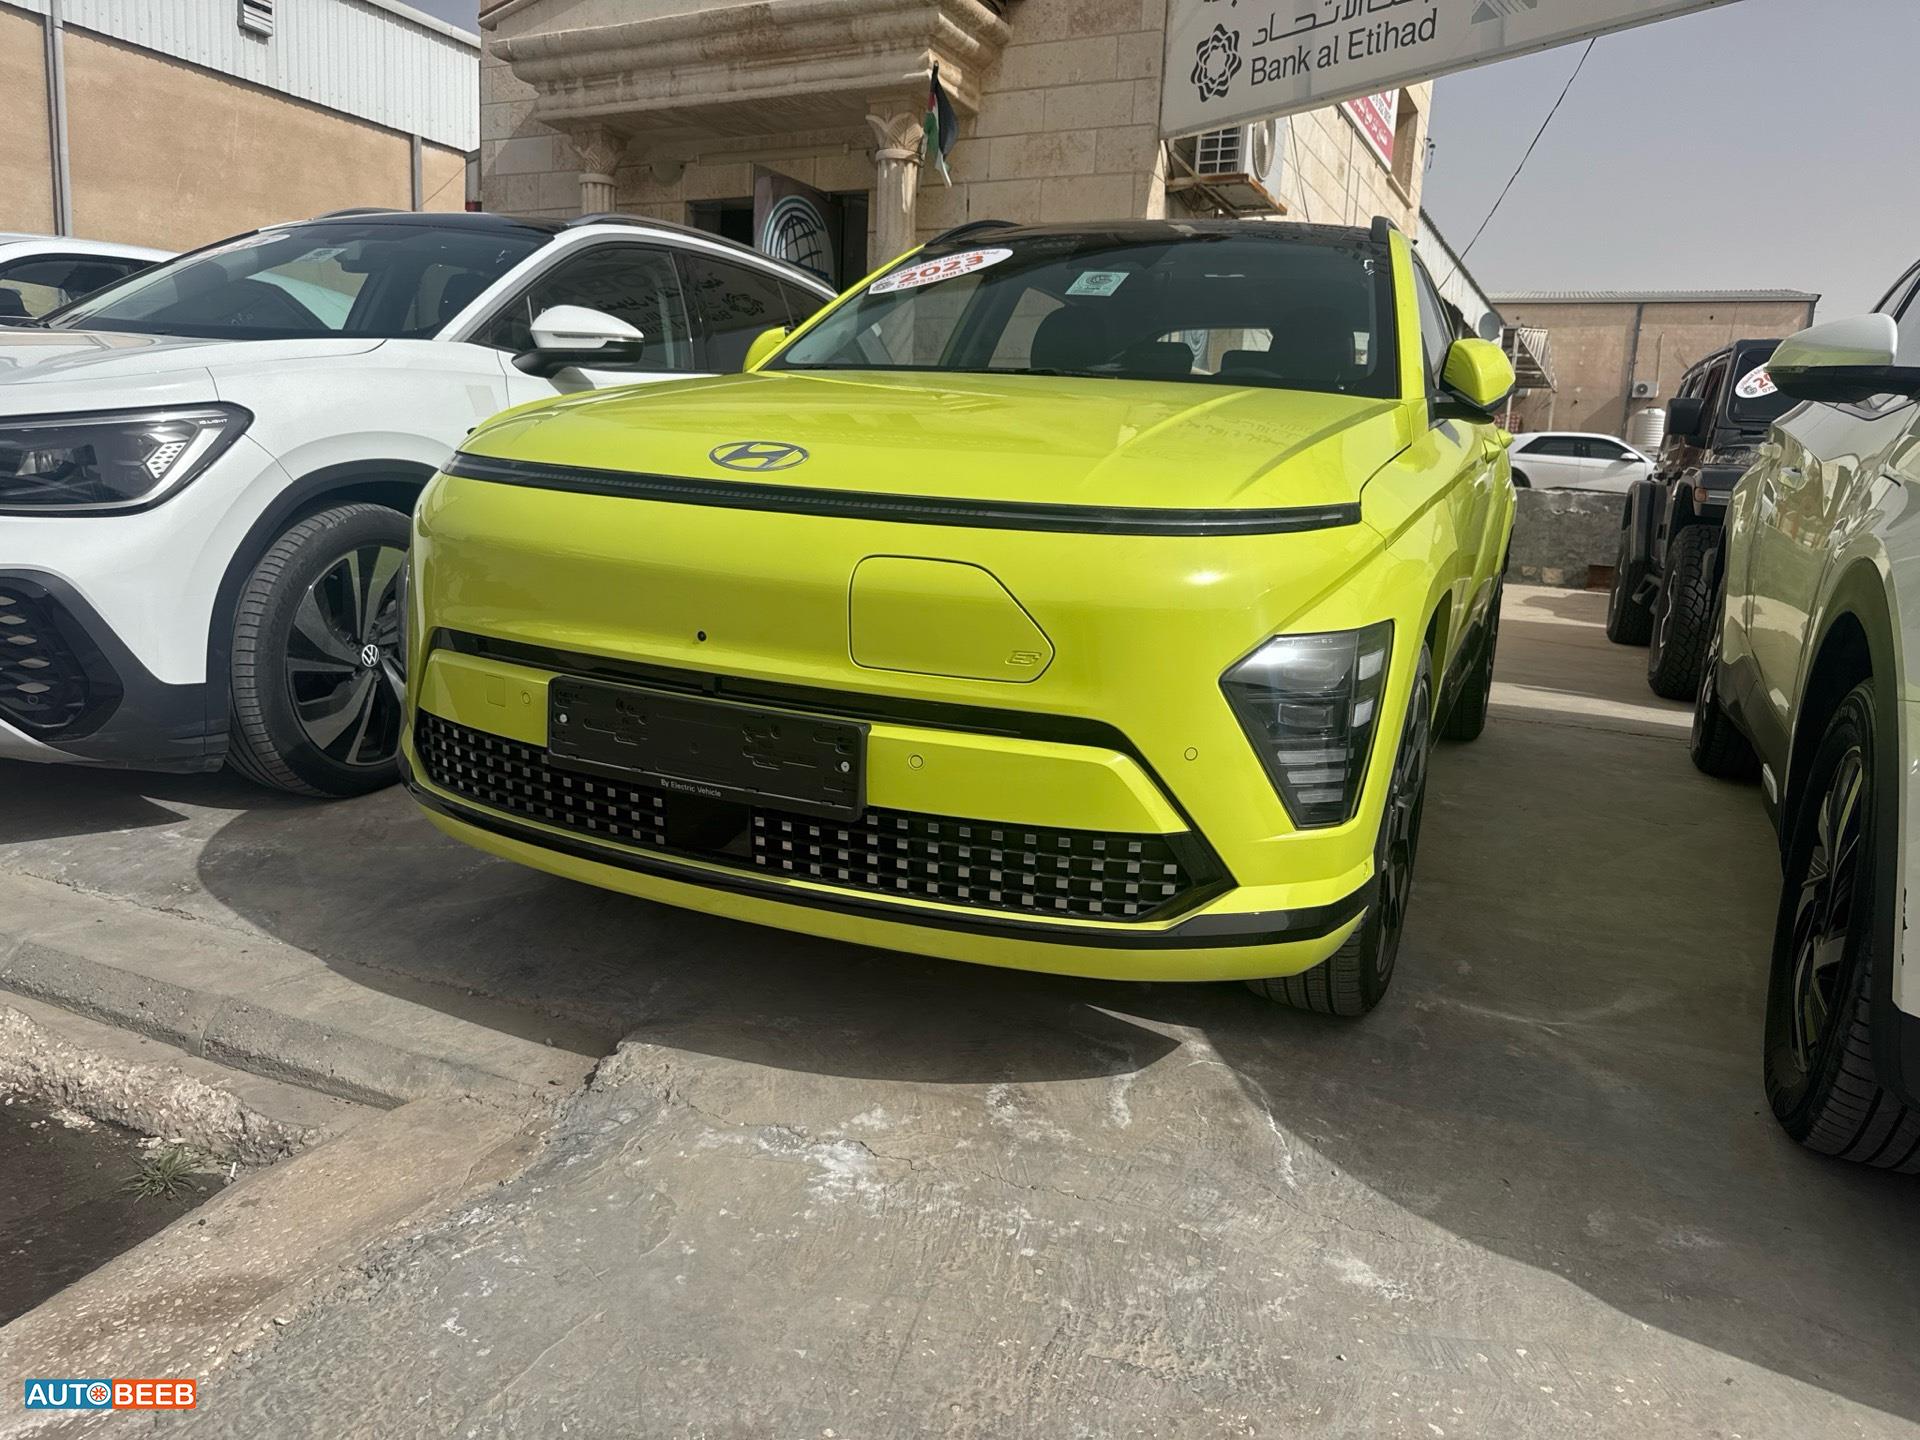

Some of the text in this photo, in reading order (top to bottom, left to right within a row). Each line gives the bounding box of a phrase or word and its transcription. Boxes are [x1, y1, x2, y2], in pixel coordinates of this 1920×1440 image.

[1251, 8, 1437, 86] Bank al Etihad
[898, 255, 983, 283] 2023
[670, 781, 695, 792] Electric
[696, 785, 721, 797] Vehicle
